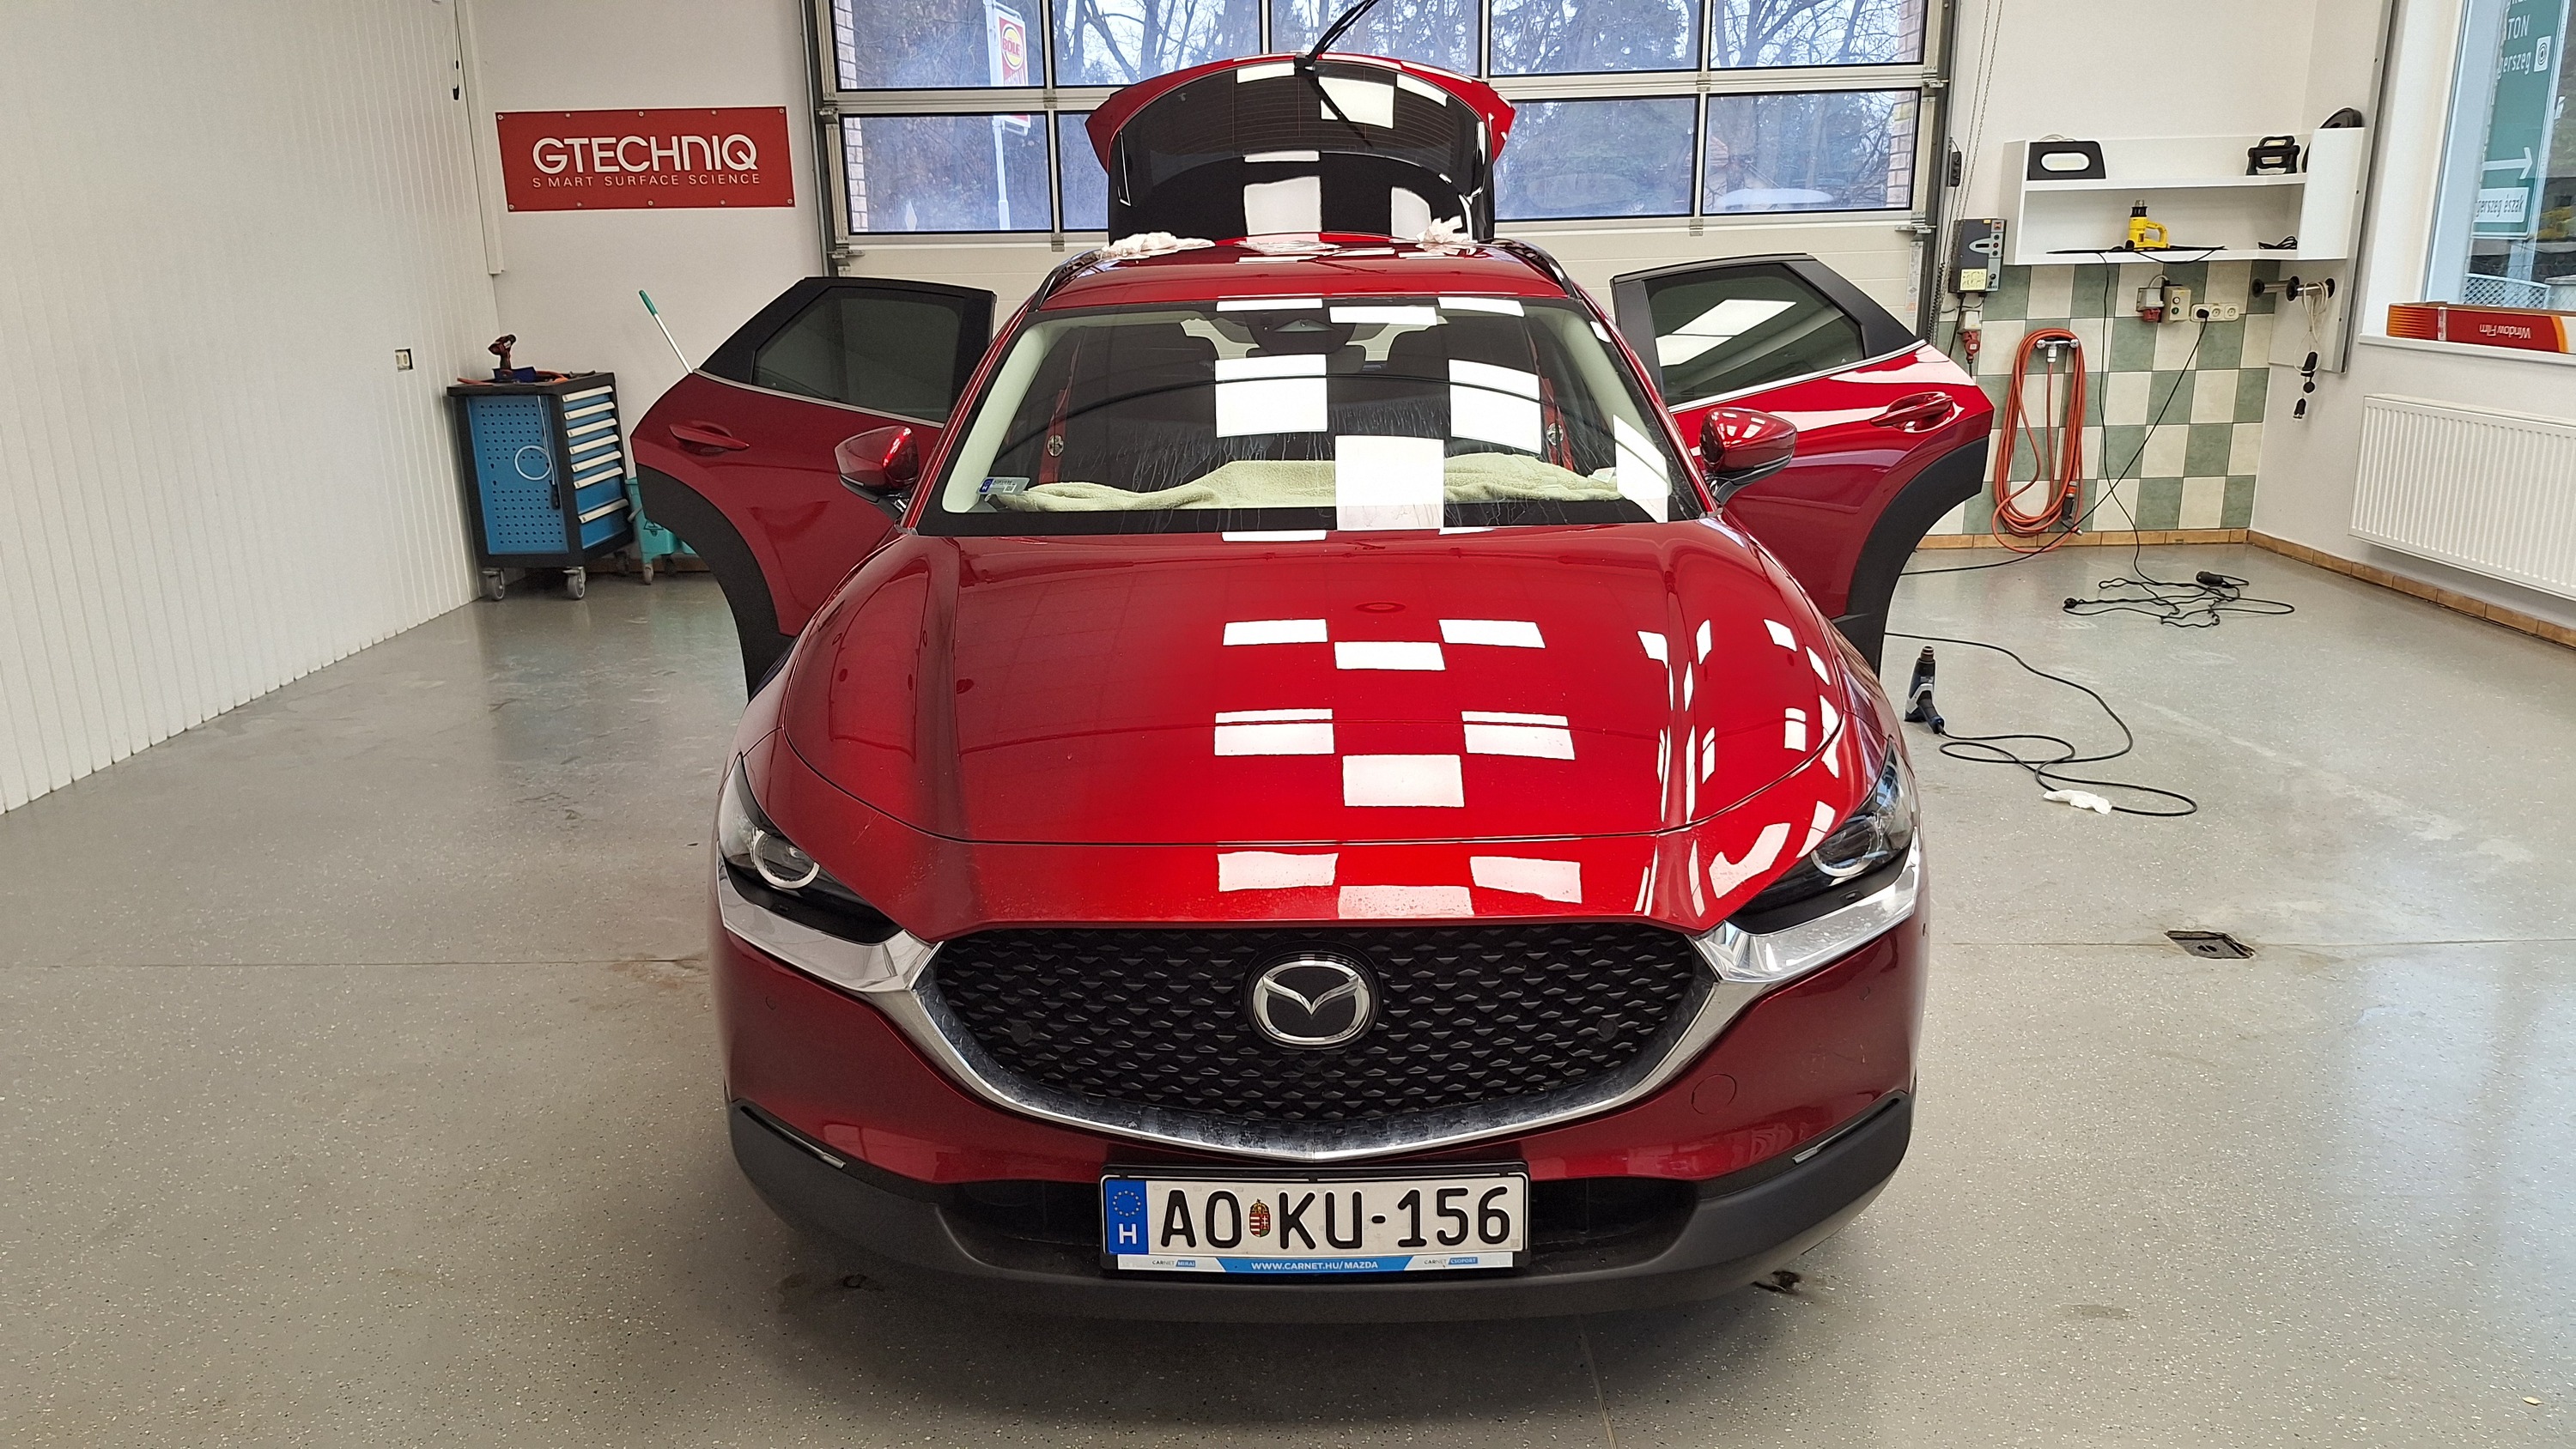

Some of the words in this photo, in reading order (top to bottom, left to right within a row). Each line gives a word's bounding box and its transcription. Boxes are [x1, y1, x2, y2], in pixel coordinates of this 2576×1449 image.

[532, 133, 758, 174] GTECHNIQ
[604, 174, 680, 187] SURFACE
[688, 173, 761, 185] SCIENCE
[2479, 323, 2497, 336] Film
[2497, 324, 2531, 339] Window
[1278, 1185, 1511, 1250] KU-156
[1118, 1223, 1138, 1245] H
